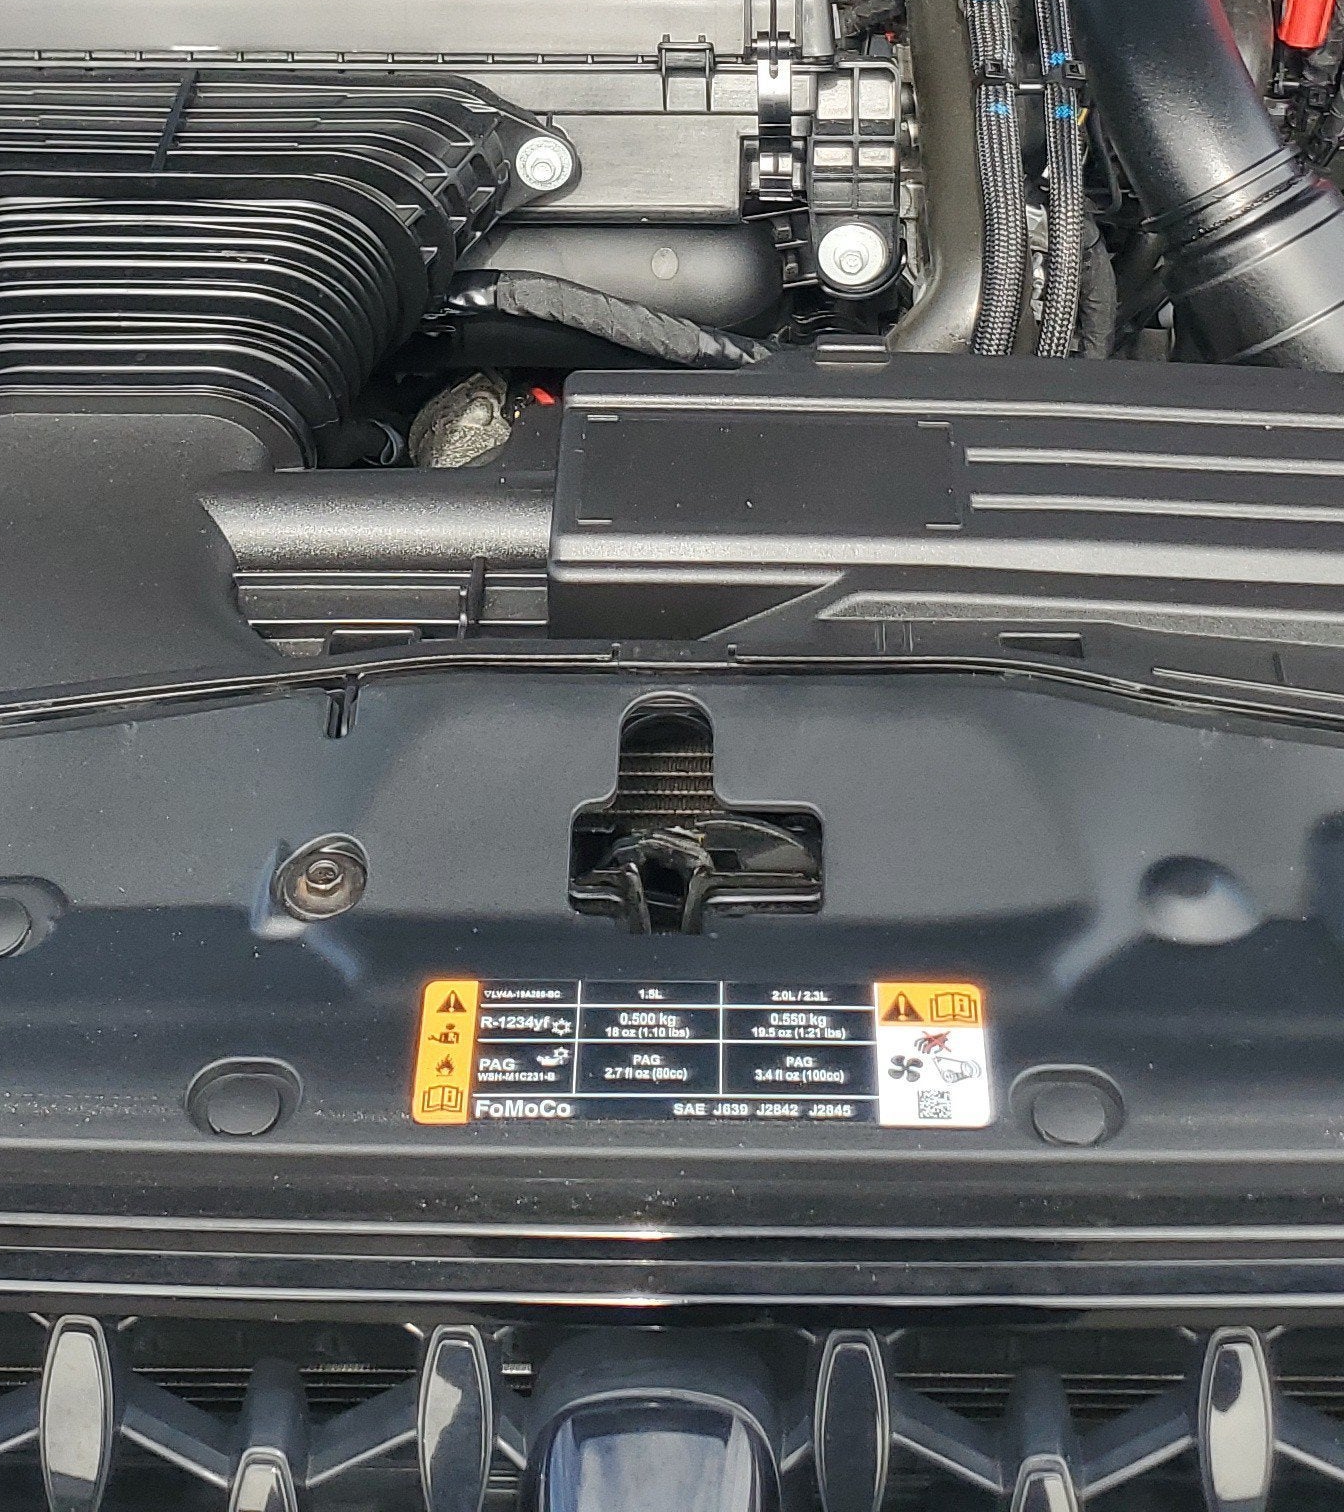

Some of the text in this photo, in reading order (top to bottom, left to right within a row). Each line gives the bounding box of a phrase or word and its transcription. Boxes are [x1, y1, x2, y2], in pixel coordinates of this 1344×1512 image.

[772, 990, 796, 1001] 2.0L
[803, 990, 829, 1001] 2.3L
[480, 1016, 550, 1031] R-1234yf
[619, 1013, 677, 1027] 0.500 kg
[770, 1013, 827, 1028] 0.550 kg
[621, 1029, 636, 1038] oz
[638, 1027, 665, 1039] (1.10
[668, 1027, 690, 1039] lbs)
[752, 1027, 846, 1040] 19.5 oz (1.21 lbs)
[479, 1058, 516, 1071] PAG
[632, 1054, 661, 1065] PAG
[786, 1056, 813, 1067] PAG
[604, 1067, 688, 1081] 2.7 fl oz (80cc)
[754, 1069, 844, 1083] 3.4 fl oz (100cc)
[475, 1099, 572, 1118] FoMoCo
[673, 1103, 852, 1116] SAE J639 J2842 J2845
